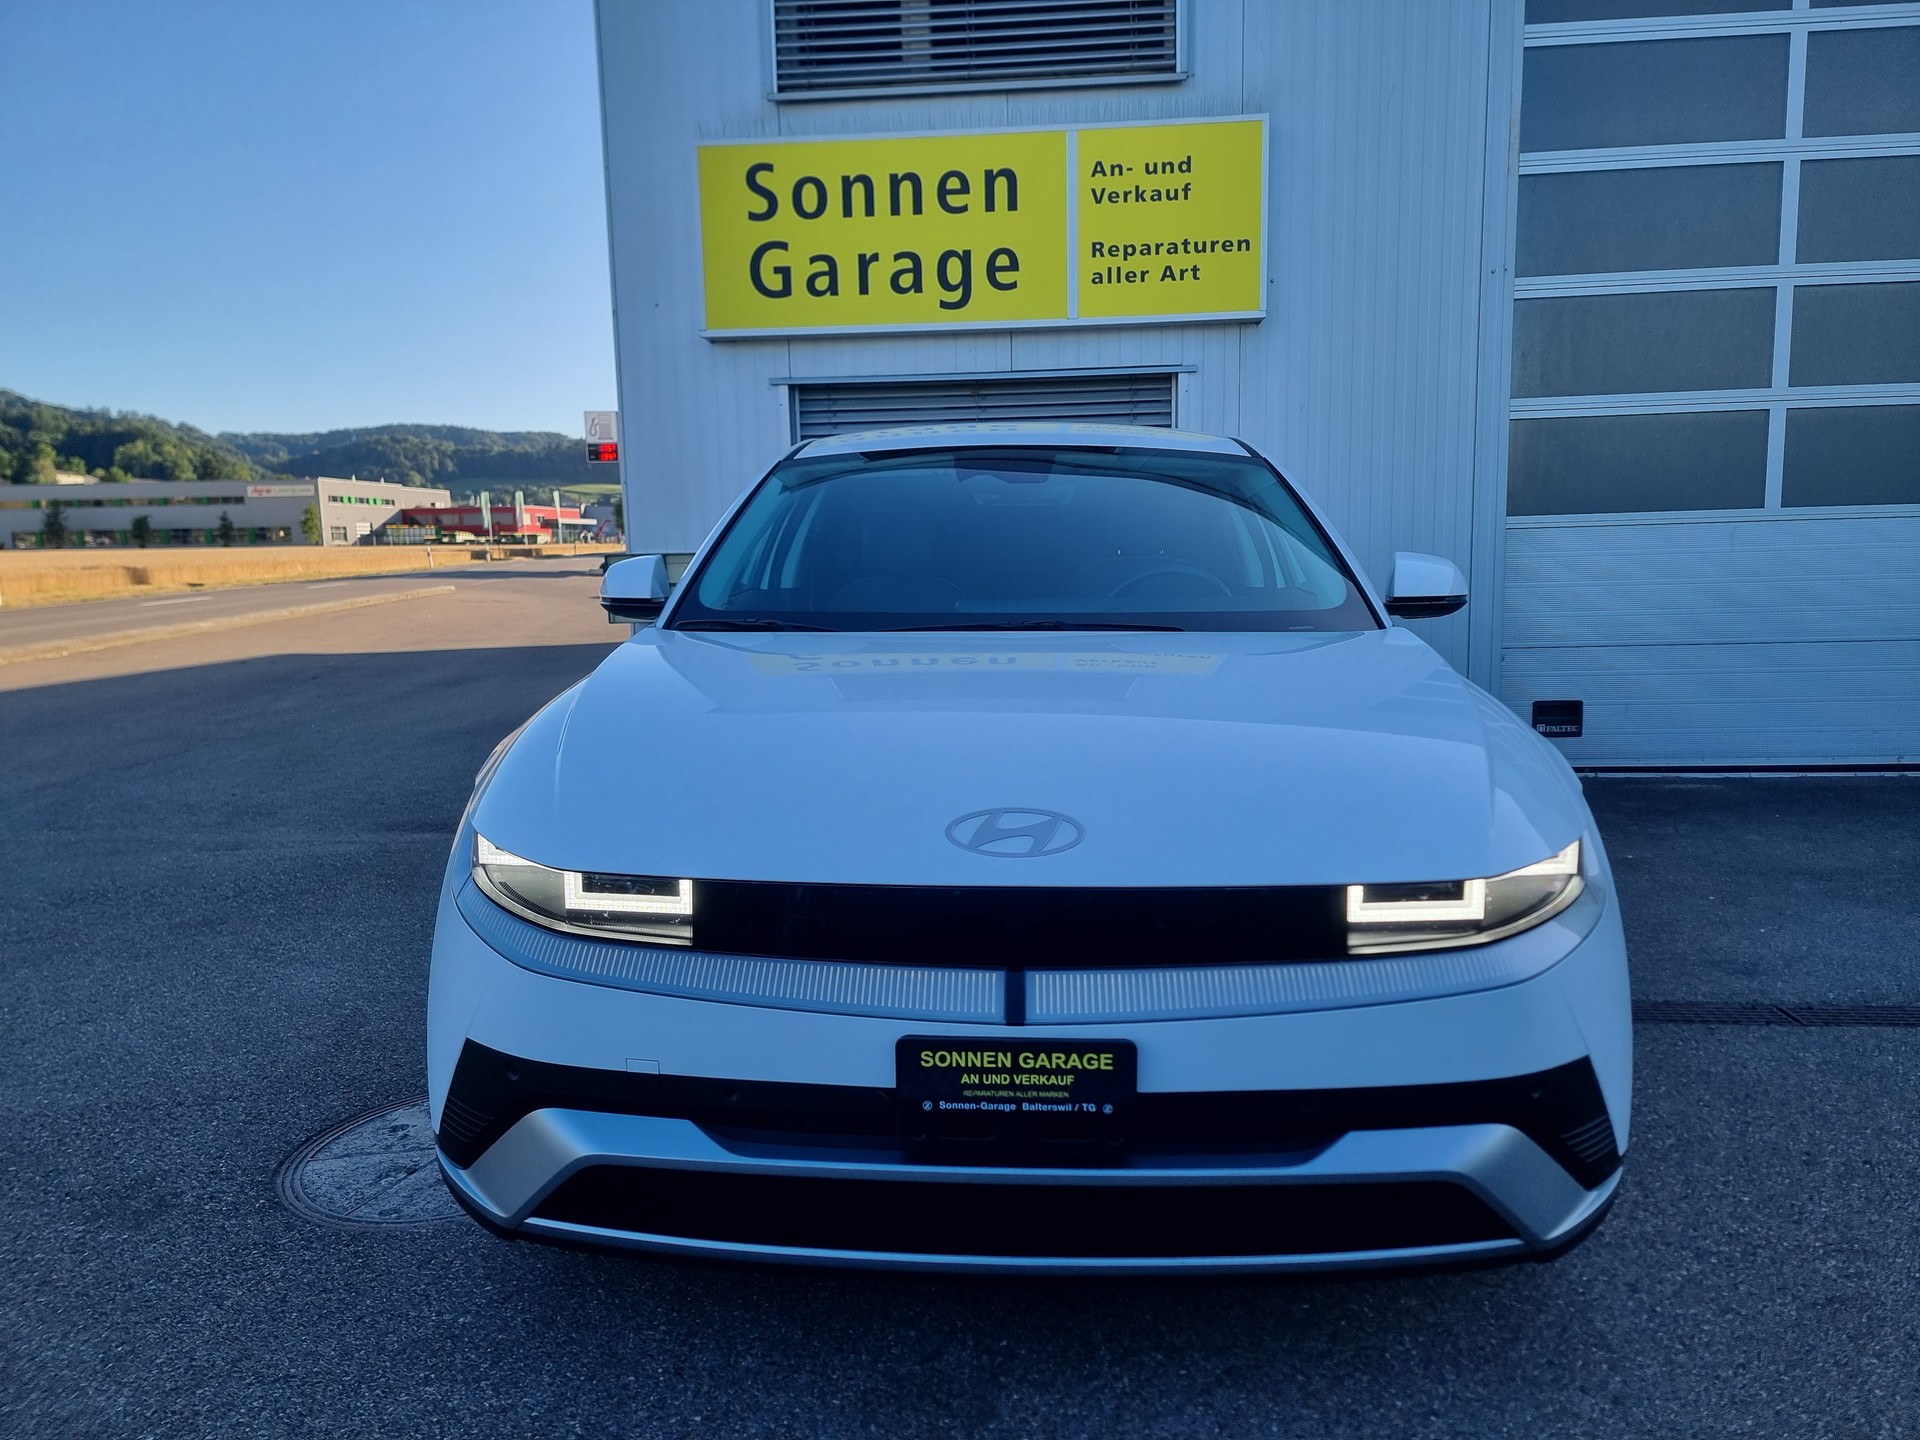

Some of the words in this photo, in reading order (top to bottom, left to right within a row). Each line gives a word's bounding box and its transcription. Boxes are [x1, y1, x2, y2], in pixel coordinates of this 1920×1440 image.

[1090, 160, 1134, 178] An-
[1144, 155, 1193, 176] und
[745, 162, 1018, 222] Sonnen
[1090, 182, 1193, 205] Verkauf
[1091, 235, 1252, 261] Reparaturen
[749, 240, 1020, 311] Garage
[1091, 266, 1150, 285] aller
[1159, 263, 1201, 282] Art
[920, 1050, 1012, 1068] SONNEN
[1018, 1052, 1114, 1070] GARAGE
[960, 1073, 979, 1085] AN
[982, 1073, 1011, 1085] UND
[1012, 1074, 1075, 1086] VERKAUF
[963, 1089, 1014, 1098] REPARATUREN
[1015, 1090, 1038, 1098] ALLER
[1038, 1091, 1070, 1099] MARKEN
[939, 1100, 1017, 1112] Sonnen-Garage
[1022, 1102, 1073, 1111] Balterswil
[1081, 1103, 1097, 1112] TG
